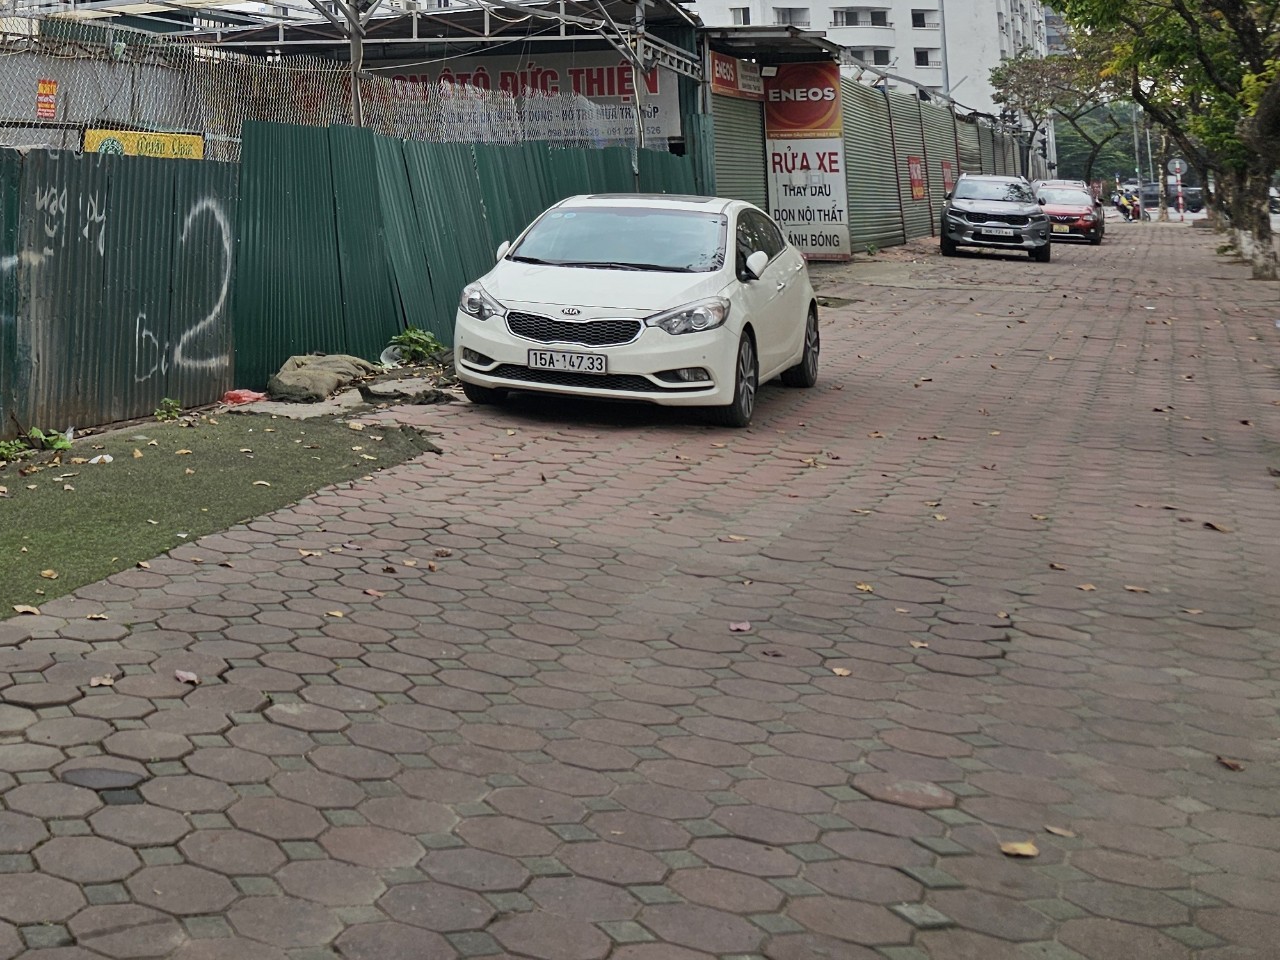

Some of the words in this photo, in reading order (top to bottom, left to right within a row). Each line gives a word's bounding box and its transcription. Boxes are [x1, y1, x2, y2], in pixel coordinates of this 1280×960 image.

[568, 60, 659, 102] THIỆN
[714, 59, 734, 82] ENEOS
[769, 87, 836, 102] ENEOS
[772, 146, 810, 174] RỬA
[816, 152, 840, 173] XE
[782, 184, 808, 196] THAY
[798, 208, 815, 225] NỘI
[817, 202, 844, 222] THẤT
[810, 230, 840, 247] BÓNG
